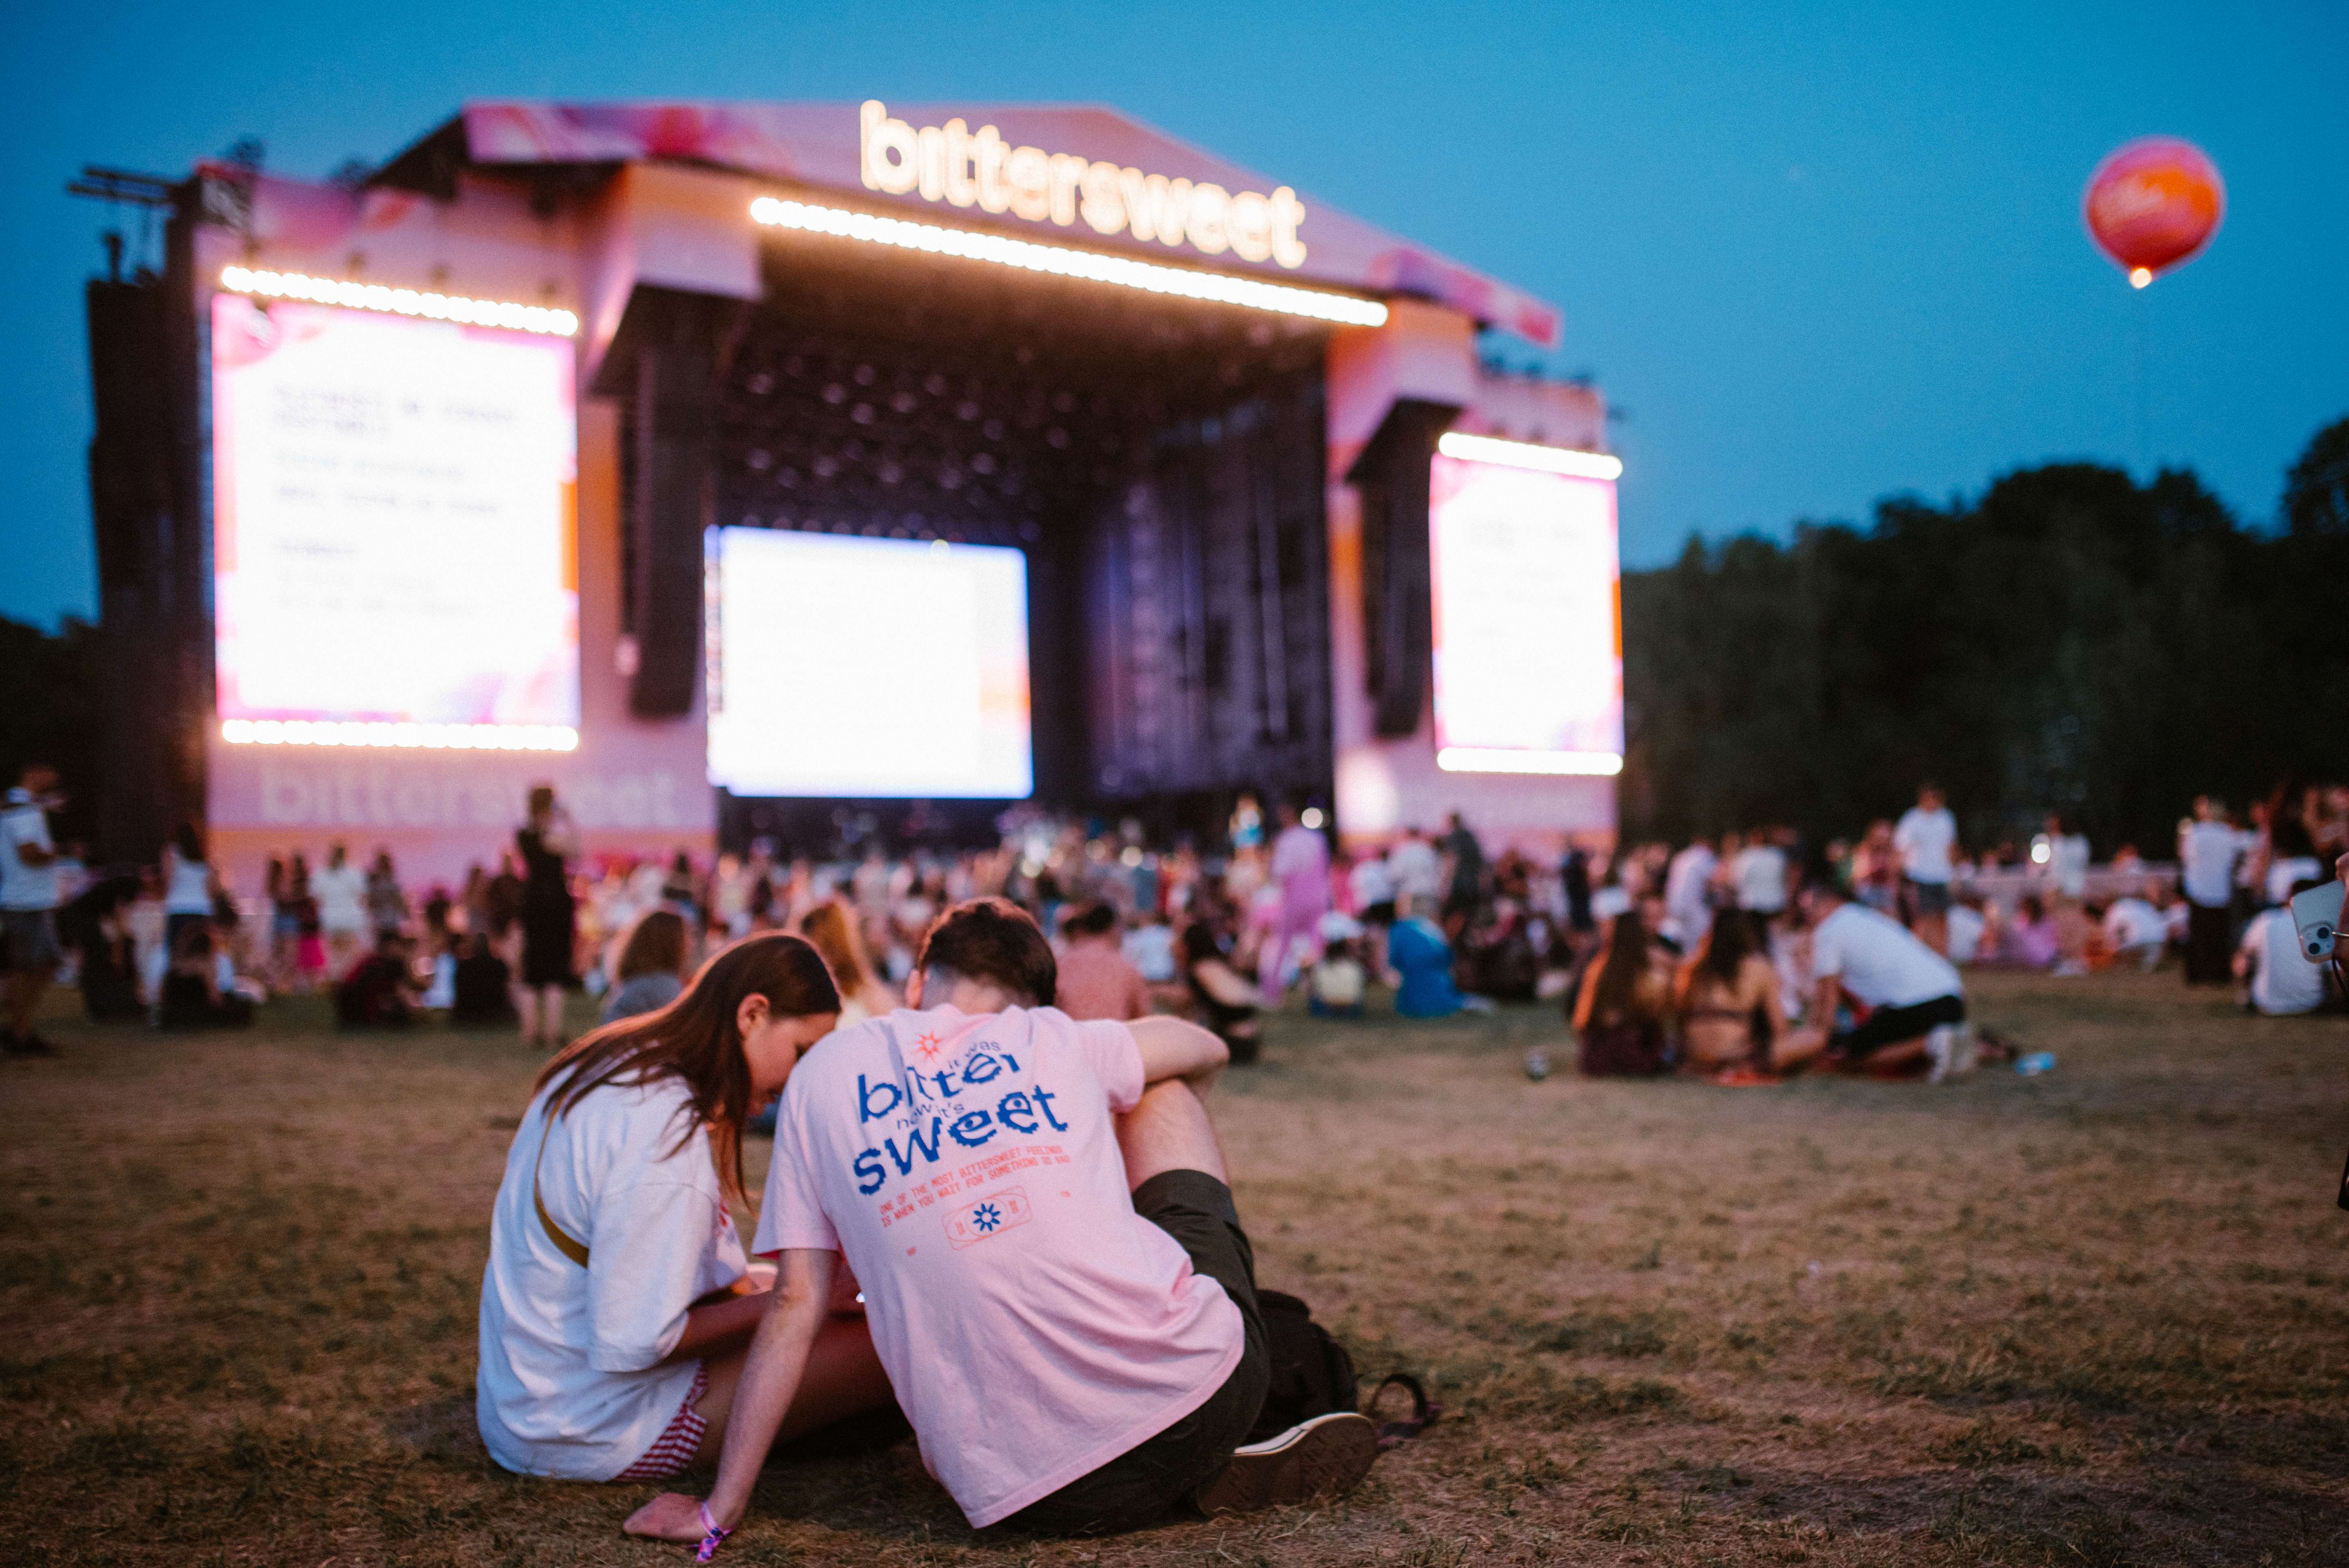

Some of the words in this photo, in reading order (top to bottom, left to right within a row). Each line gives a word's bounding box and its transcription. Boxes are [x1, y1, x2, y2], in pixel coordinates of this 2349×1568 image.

[860, 99, 1307, 270] bittersweet
[965, 1041, 1000, 1057] was
[853, 1085, 1068, 1195] sweet
[897, 1104, 932, 1130] now
[879, 1200, 894, 1215] ONE
[911, 1182, 928, 1197] THE
[931, 1171, 953, 1187] MOST
[959, 1146, 1021, 1178] BITTERSWEET
[894, 1203, 915, 1220] WHEN
[917, 1193, 935, 1207] YOU
[966, 1174, 984, 1188] FOR
